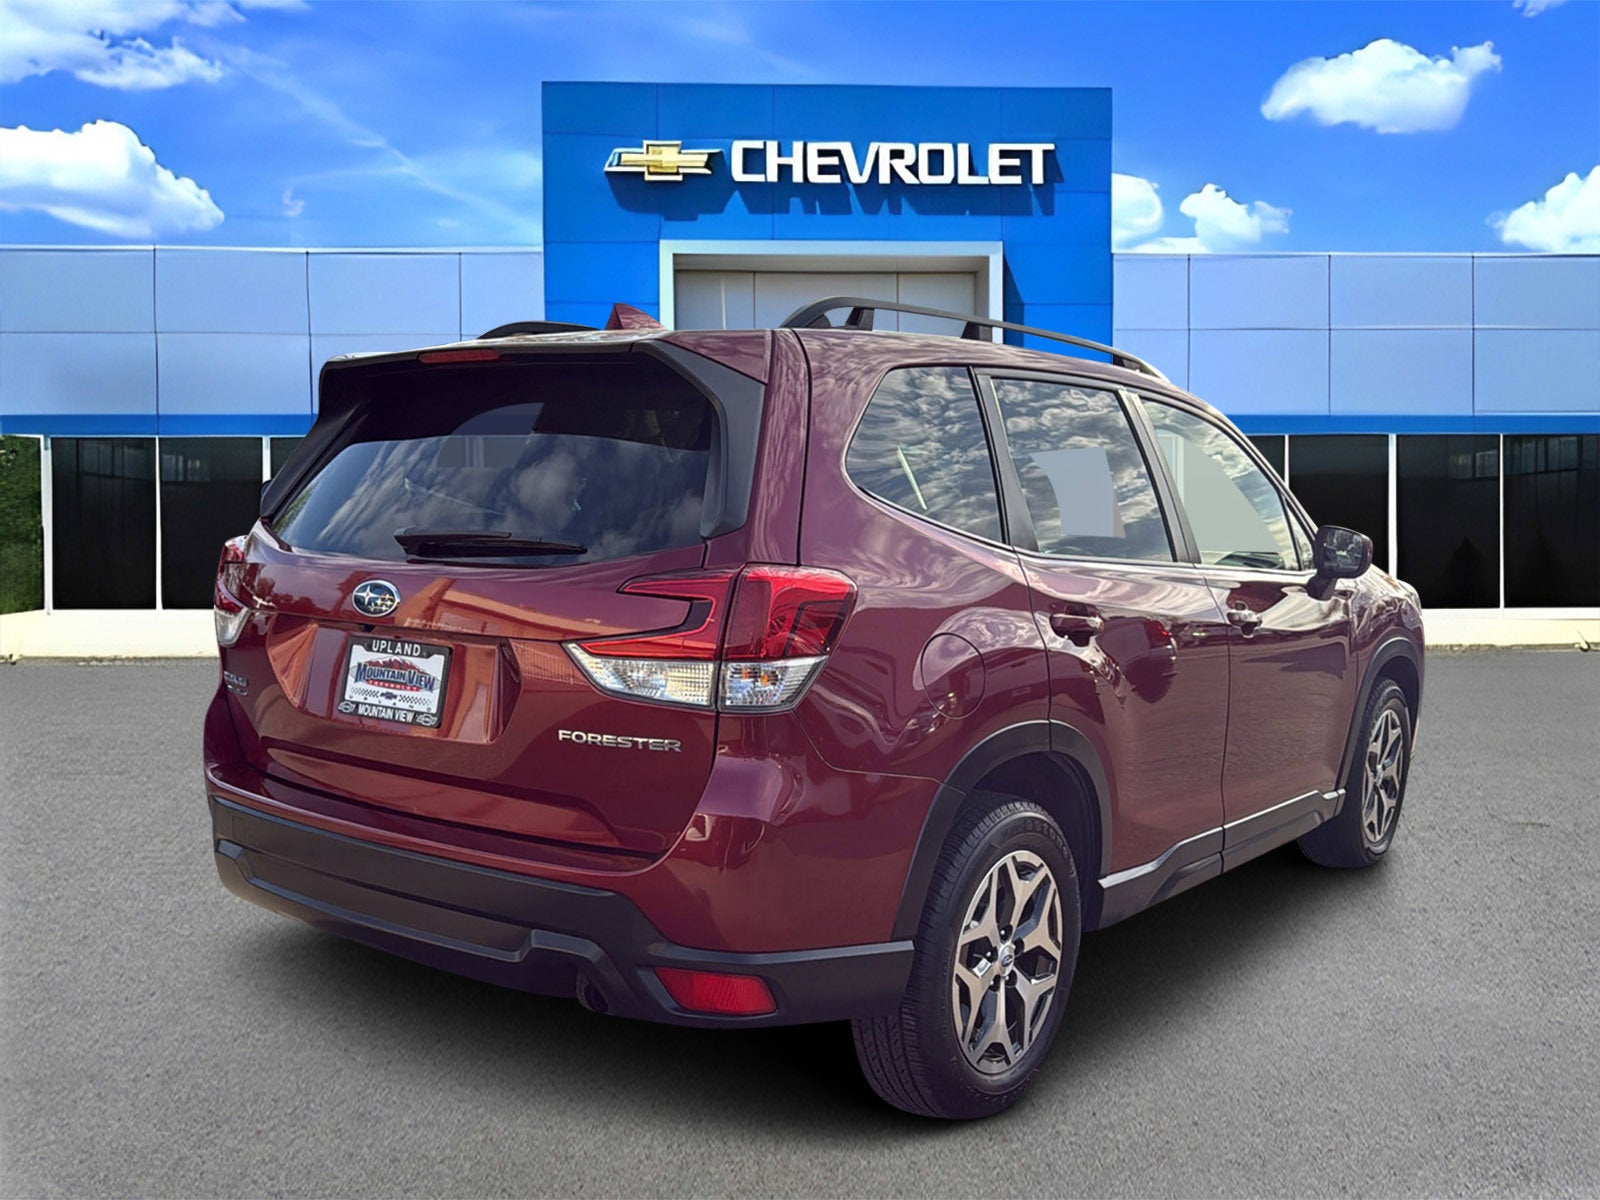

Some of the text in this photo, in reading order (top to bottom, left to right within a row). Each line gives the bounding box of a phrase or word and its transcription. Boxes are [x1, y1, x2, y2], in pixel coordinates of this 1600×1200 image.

[730, 140, 1055, 184] CHEVROLET
[372, 639, 421, 656] UPLAND
[354, 662, 435, 693] MOUNTAIN VIEW
[358, 703, 415, 723] MOUNTAIN VIEW
[558, 729, 682, 752] FORESTER
